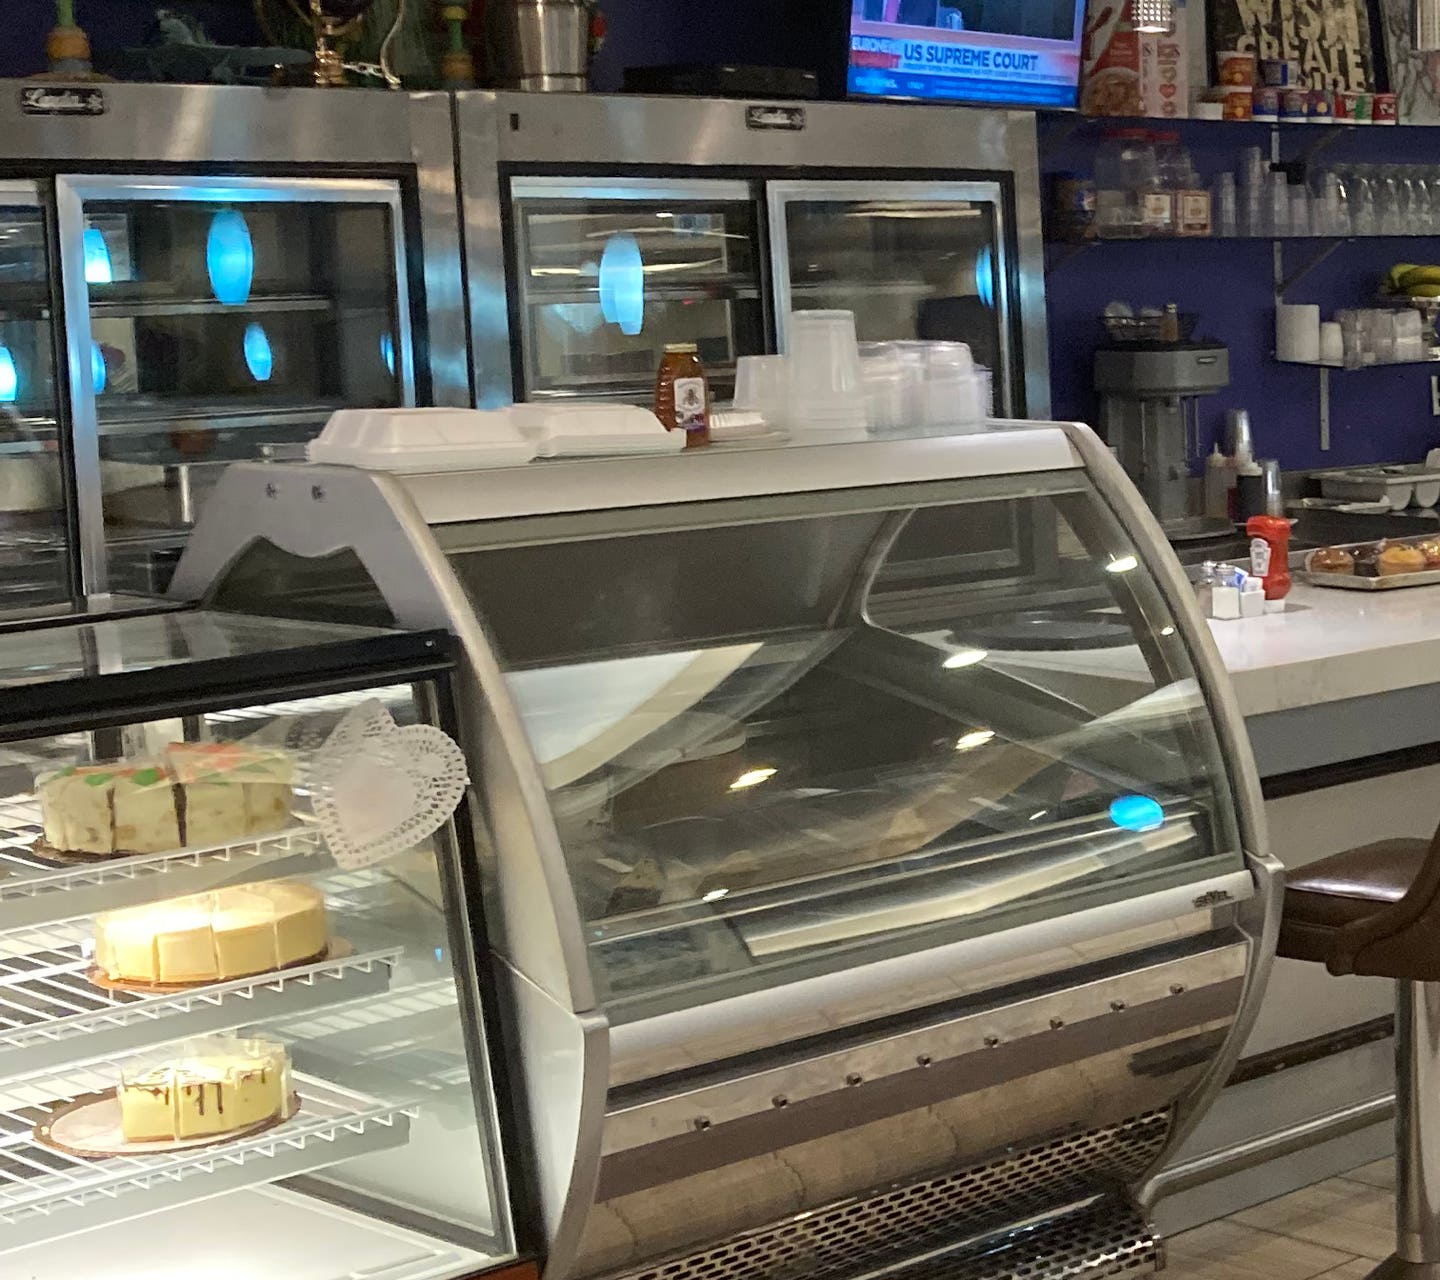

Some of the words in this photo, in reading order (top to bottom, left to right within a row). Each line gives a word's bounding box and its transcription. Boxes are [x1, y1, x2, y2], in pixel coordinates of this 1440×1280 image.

[904, 43, 923, 62] US
[926, 45, 990, 68] SUPREME
[993, 51, 1039, 72] COURT
